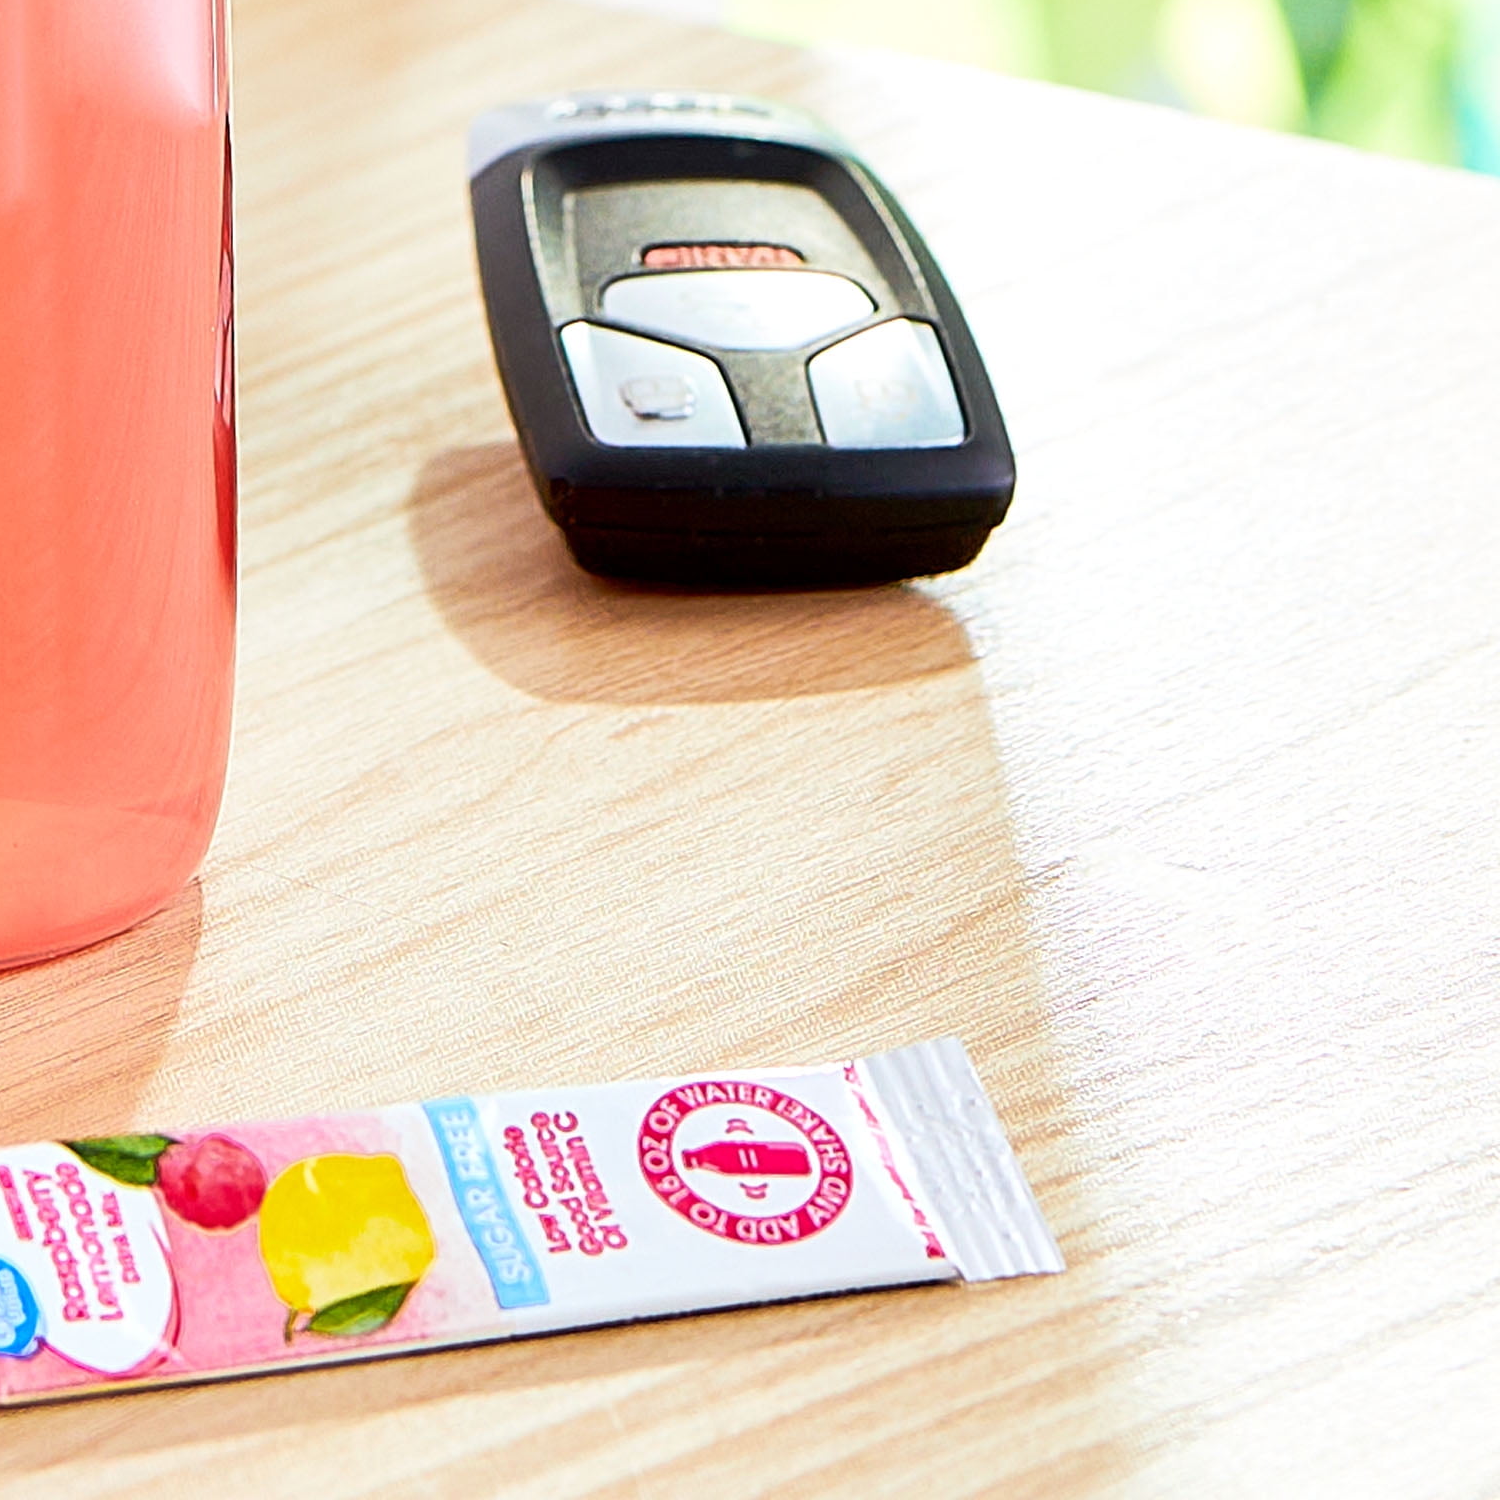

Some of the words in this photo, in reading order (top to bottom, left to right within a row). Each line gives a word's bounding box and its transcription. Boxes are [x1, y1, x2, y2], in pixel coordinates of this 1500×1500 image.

[649, 1098, 682, 1133] OF
[677, 1082, 773, 1109] WATER
[439, 1108, 490, 1180] FREE
[553, 1110, 579, 1133] C
[503, 1125, 549, 1209] Calorie
[530, 1111, 575, 1193] Source
[642, 1137, 671, 1173] OZ
[566, 1135, 614, 1221] Vitamin
[656, 1174, 690, 1205] 16
[807, 1176, 848, 1227] AND
[22, 1168, 90, 1322] Raspberry
[55, 1162, 124, 1321] Lemonade
[465, 1185, 533, 1285] SUGAR
[538, 1213, 572, 1253] Low
[558, 1197, 604, 1257] Good
[689, 1205, 729, 1235] TO
[736, 1215, 800, 1243] ADD
